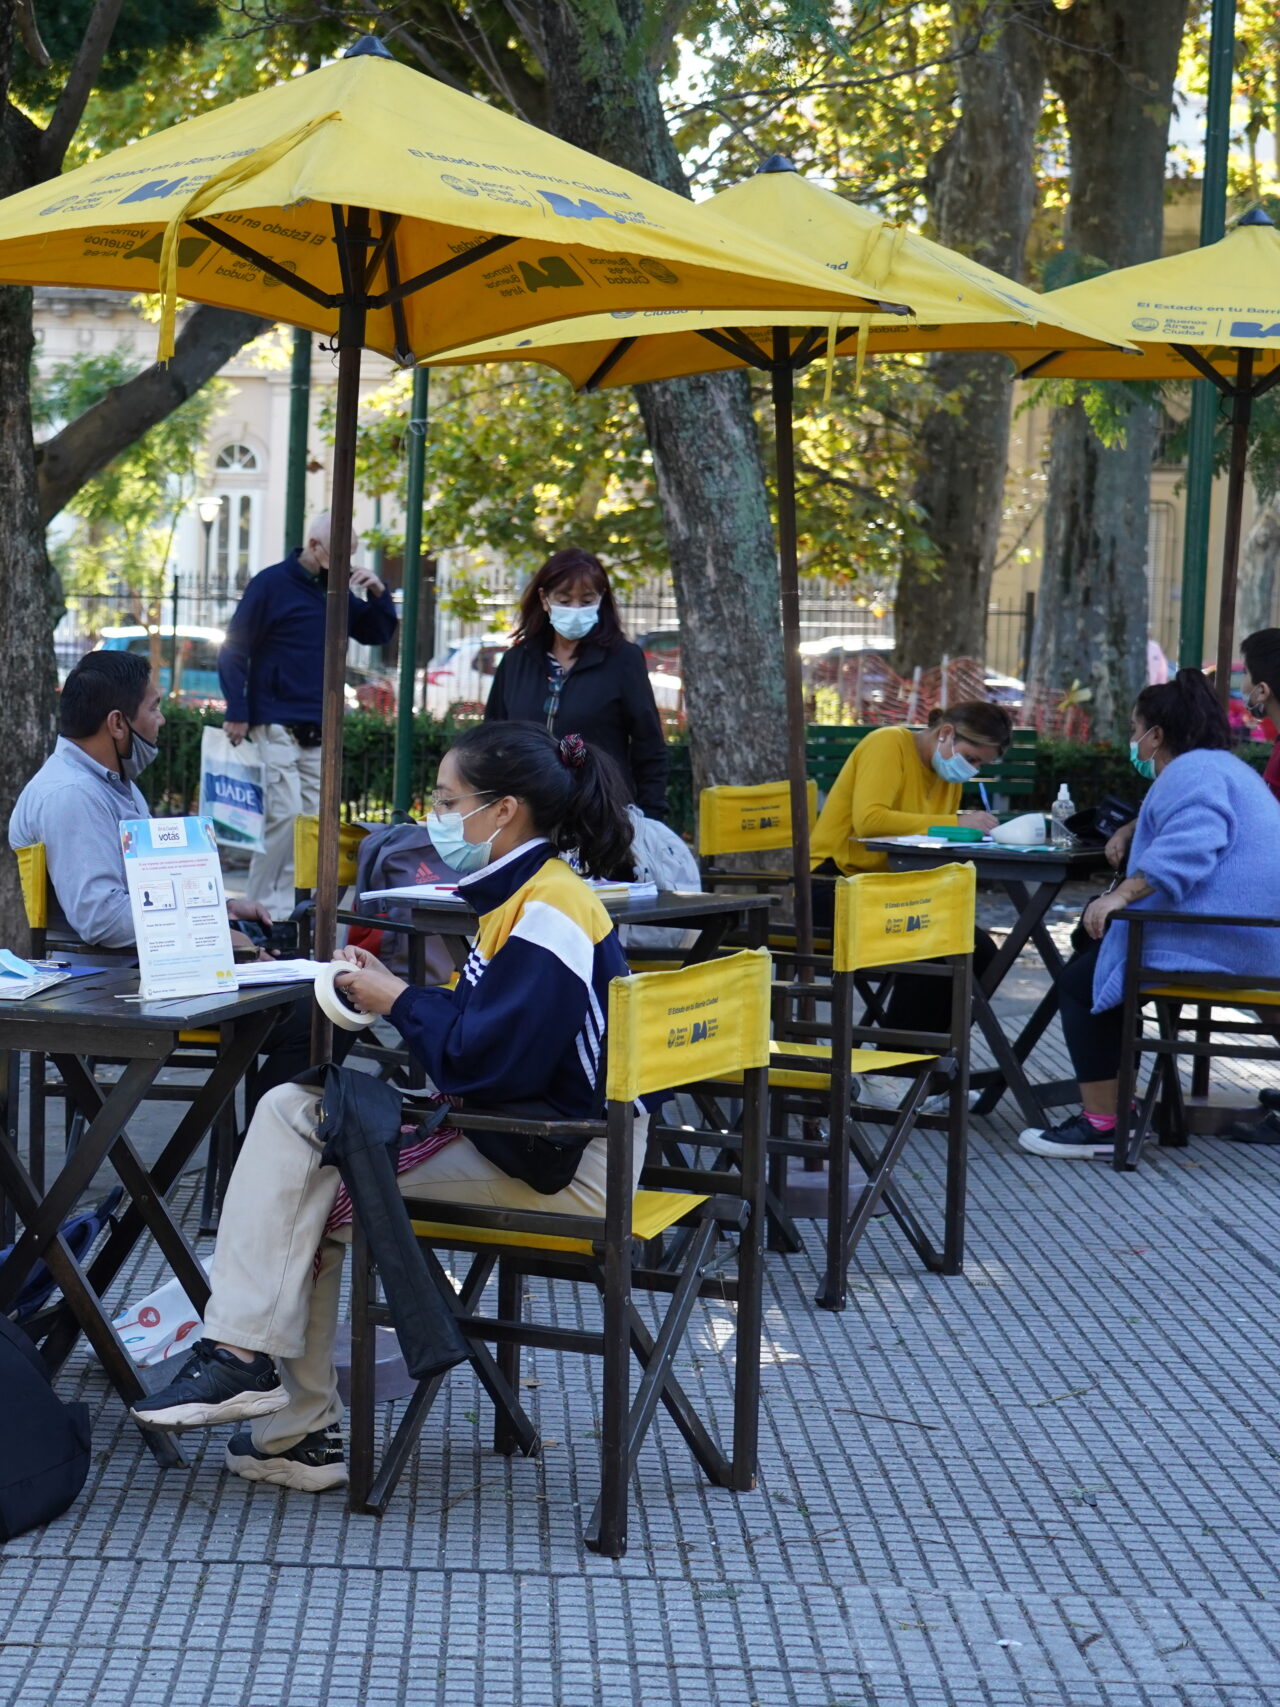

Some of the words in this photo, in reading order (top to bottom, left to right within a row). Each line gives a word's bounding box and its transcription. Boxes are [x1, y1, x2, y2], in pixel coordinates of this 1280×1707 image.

[407, 148, 426, 158] El
[424, 151, 481, 168] Estado
[521, 169, 570, 185] Barrio
[572, 181, 633, 200] Ciudad
[1154, 303, 1203, 312] Estado
[214, 782, 256, 806] UADE
[158, 831, 180, 842] votás
[690, 1020, 708, 1044] BA
